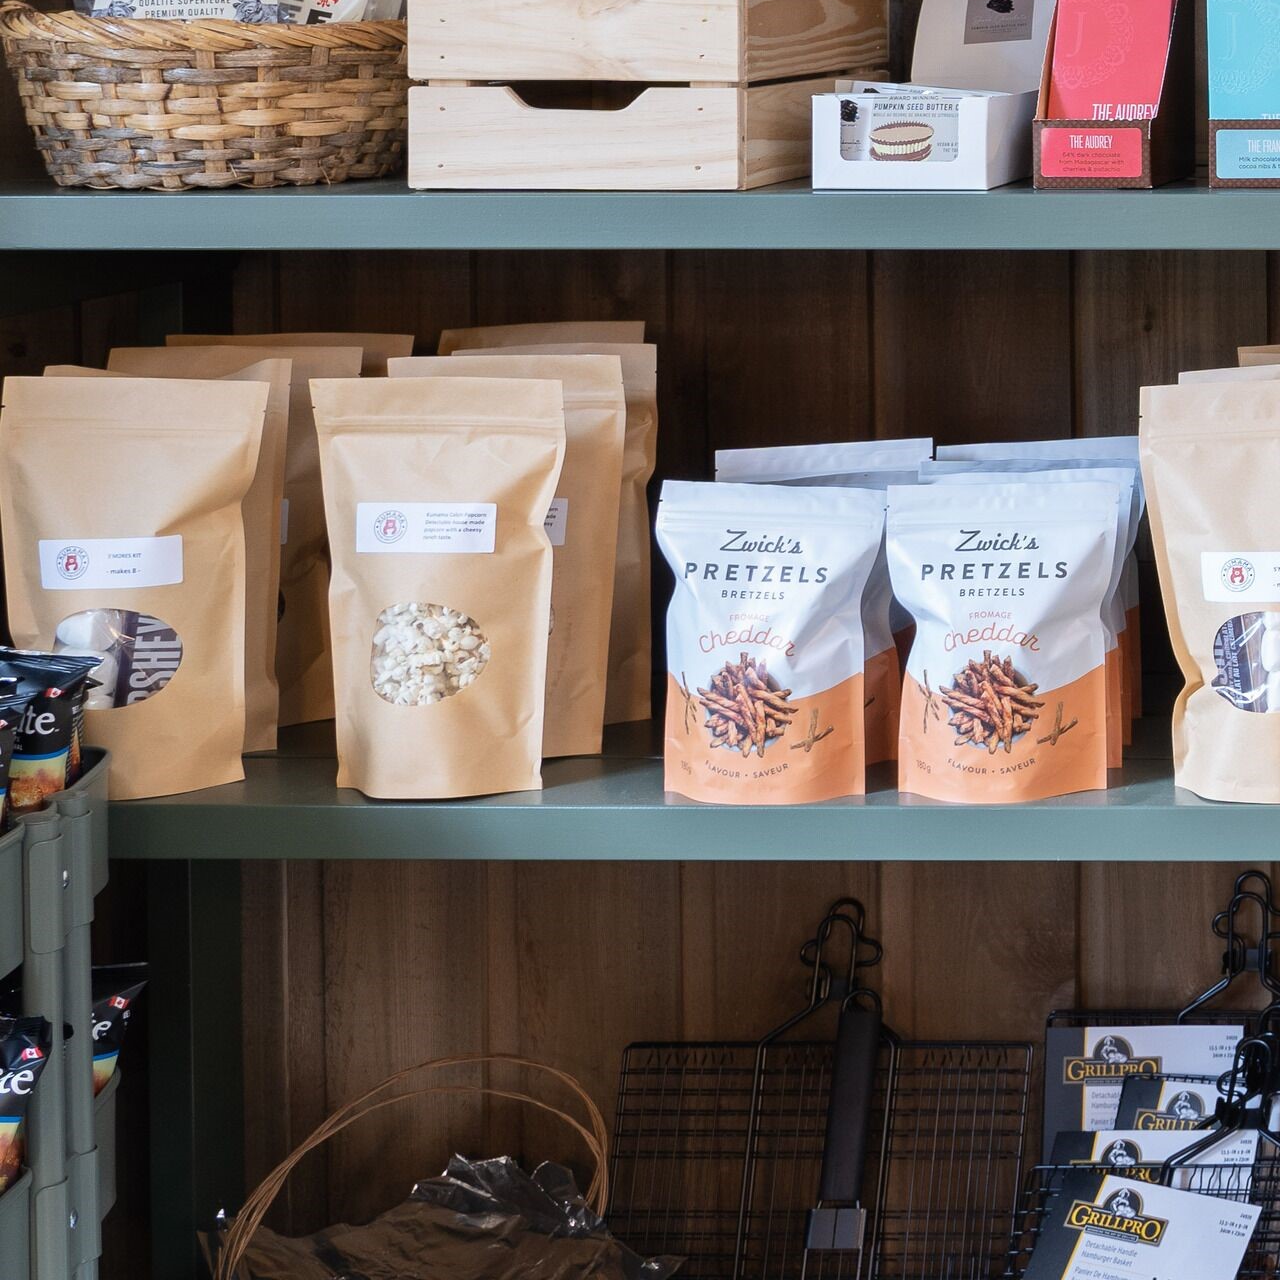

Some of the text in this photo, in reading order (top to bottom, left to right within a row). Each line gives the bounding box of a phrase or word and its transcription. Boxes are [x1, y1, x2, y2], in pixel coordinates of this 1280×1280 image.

[145, 8, 224, 18] PREMIUM QUALITY
[1069, 135, 1112, 148] THE AUDREY
[1248, 140, 1261, 153] THE
[719, 529, 803, 554] Zwick's
[955, 530, 1039, 551] Zwick's
[685, 562, 828, 584] PRETZELS
[922, 562, 1068, 580] PRETZELS
[722, 590, 784, 600] BRETZELS
[959, 588, 1025, 596] BRETZELS
[969, 611, 1012, 620] FROMAGE
